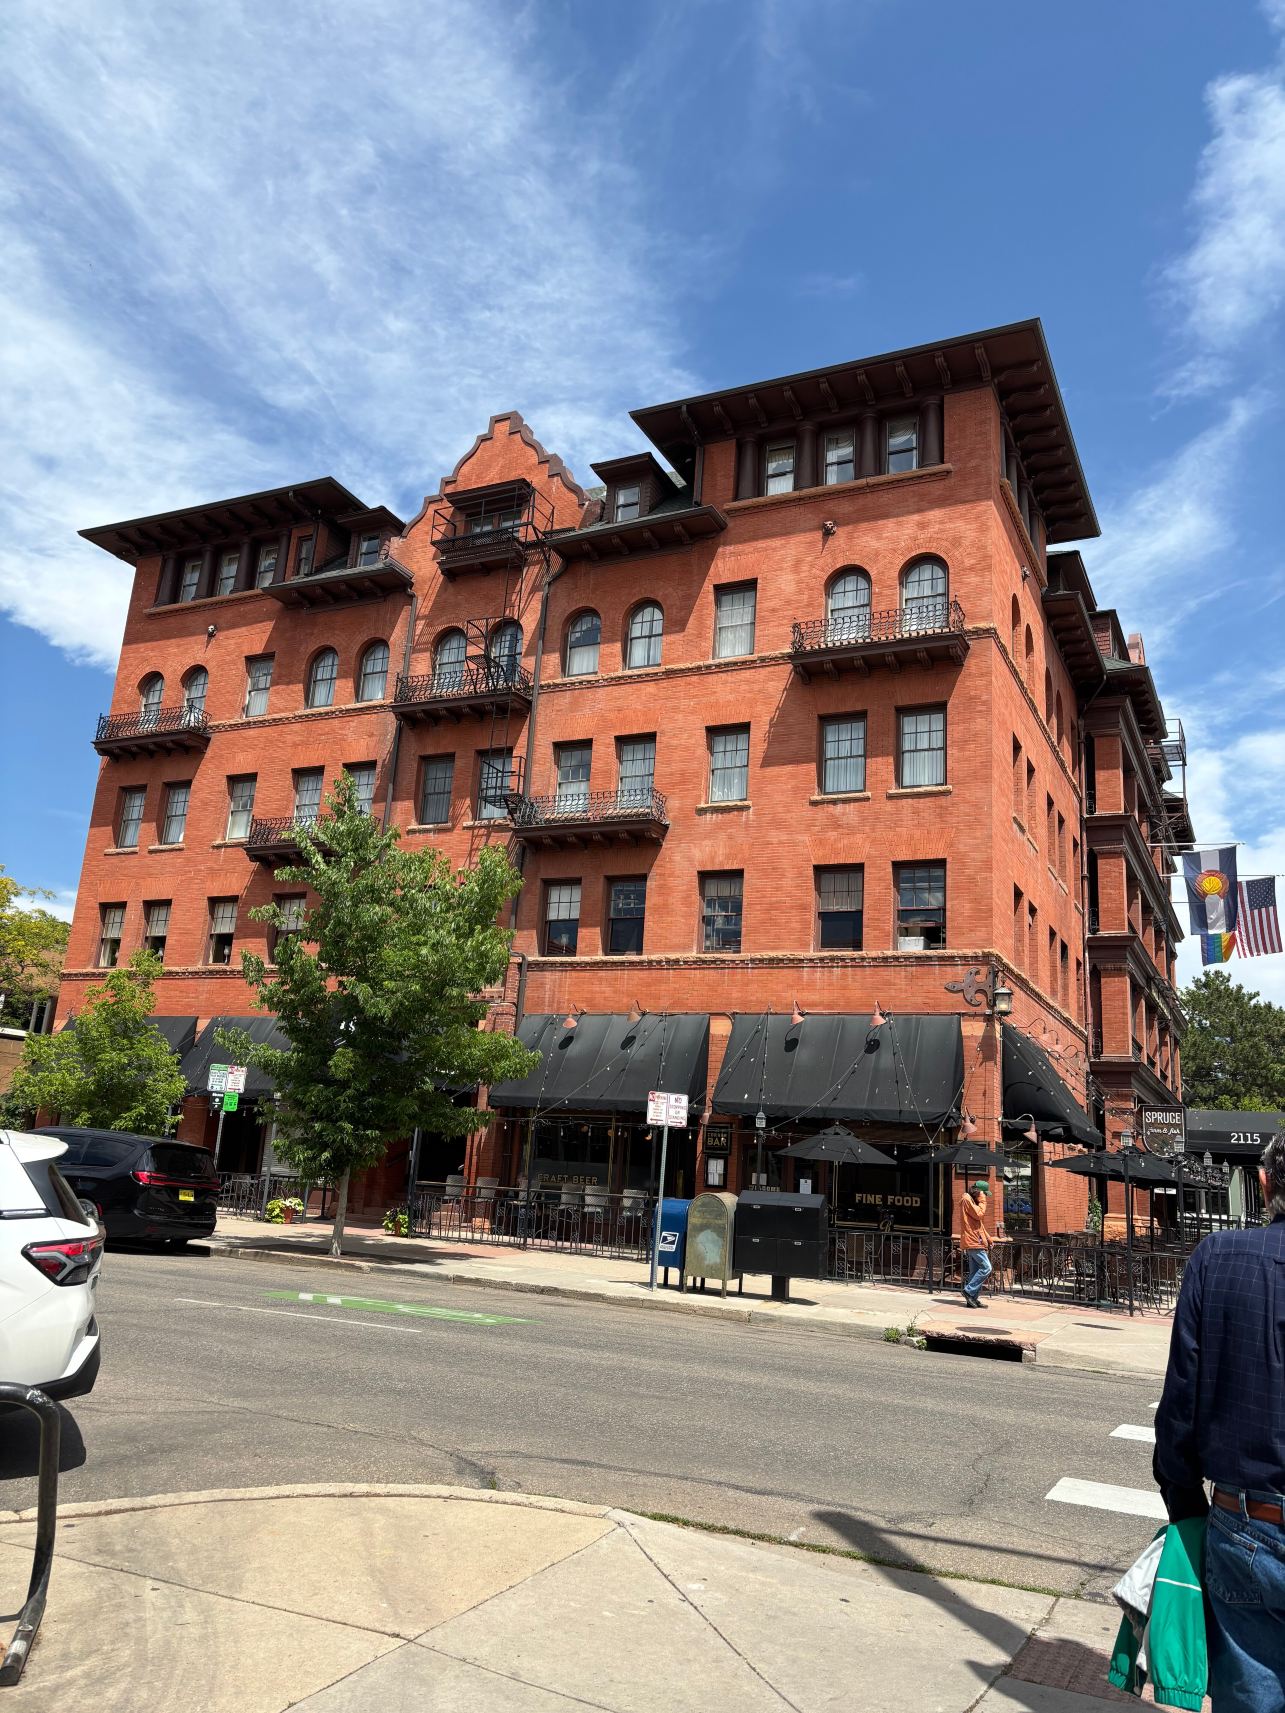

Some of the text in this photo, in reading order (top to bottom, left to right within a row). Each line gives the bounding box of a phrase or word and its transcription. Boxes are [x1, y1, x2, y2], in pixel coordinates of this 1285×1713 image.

[674, 1096, 683, 1104] NO
[1145, 1111, 1181, 1124] SPRUCE
[707, 1137, 727, 1146] BAR
[1230, 1133, 1260, 1144] 2115
[537, 1173, 598, 1185] CRAFT BEER
[855, 1193, 920, 1207] FINE FOOD
